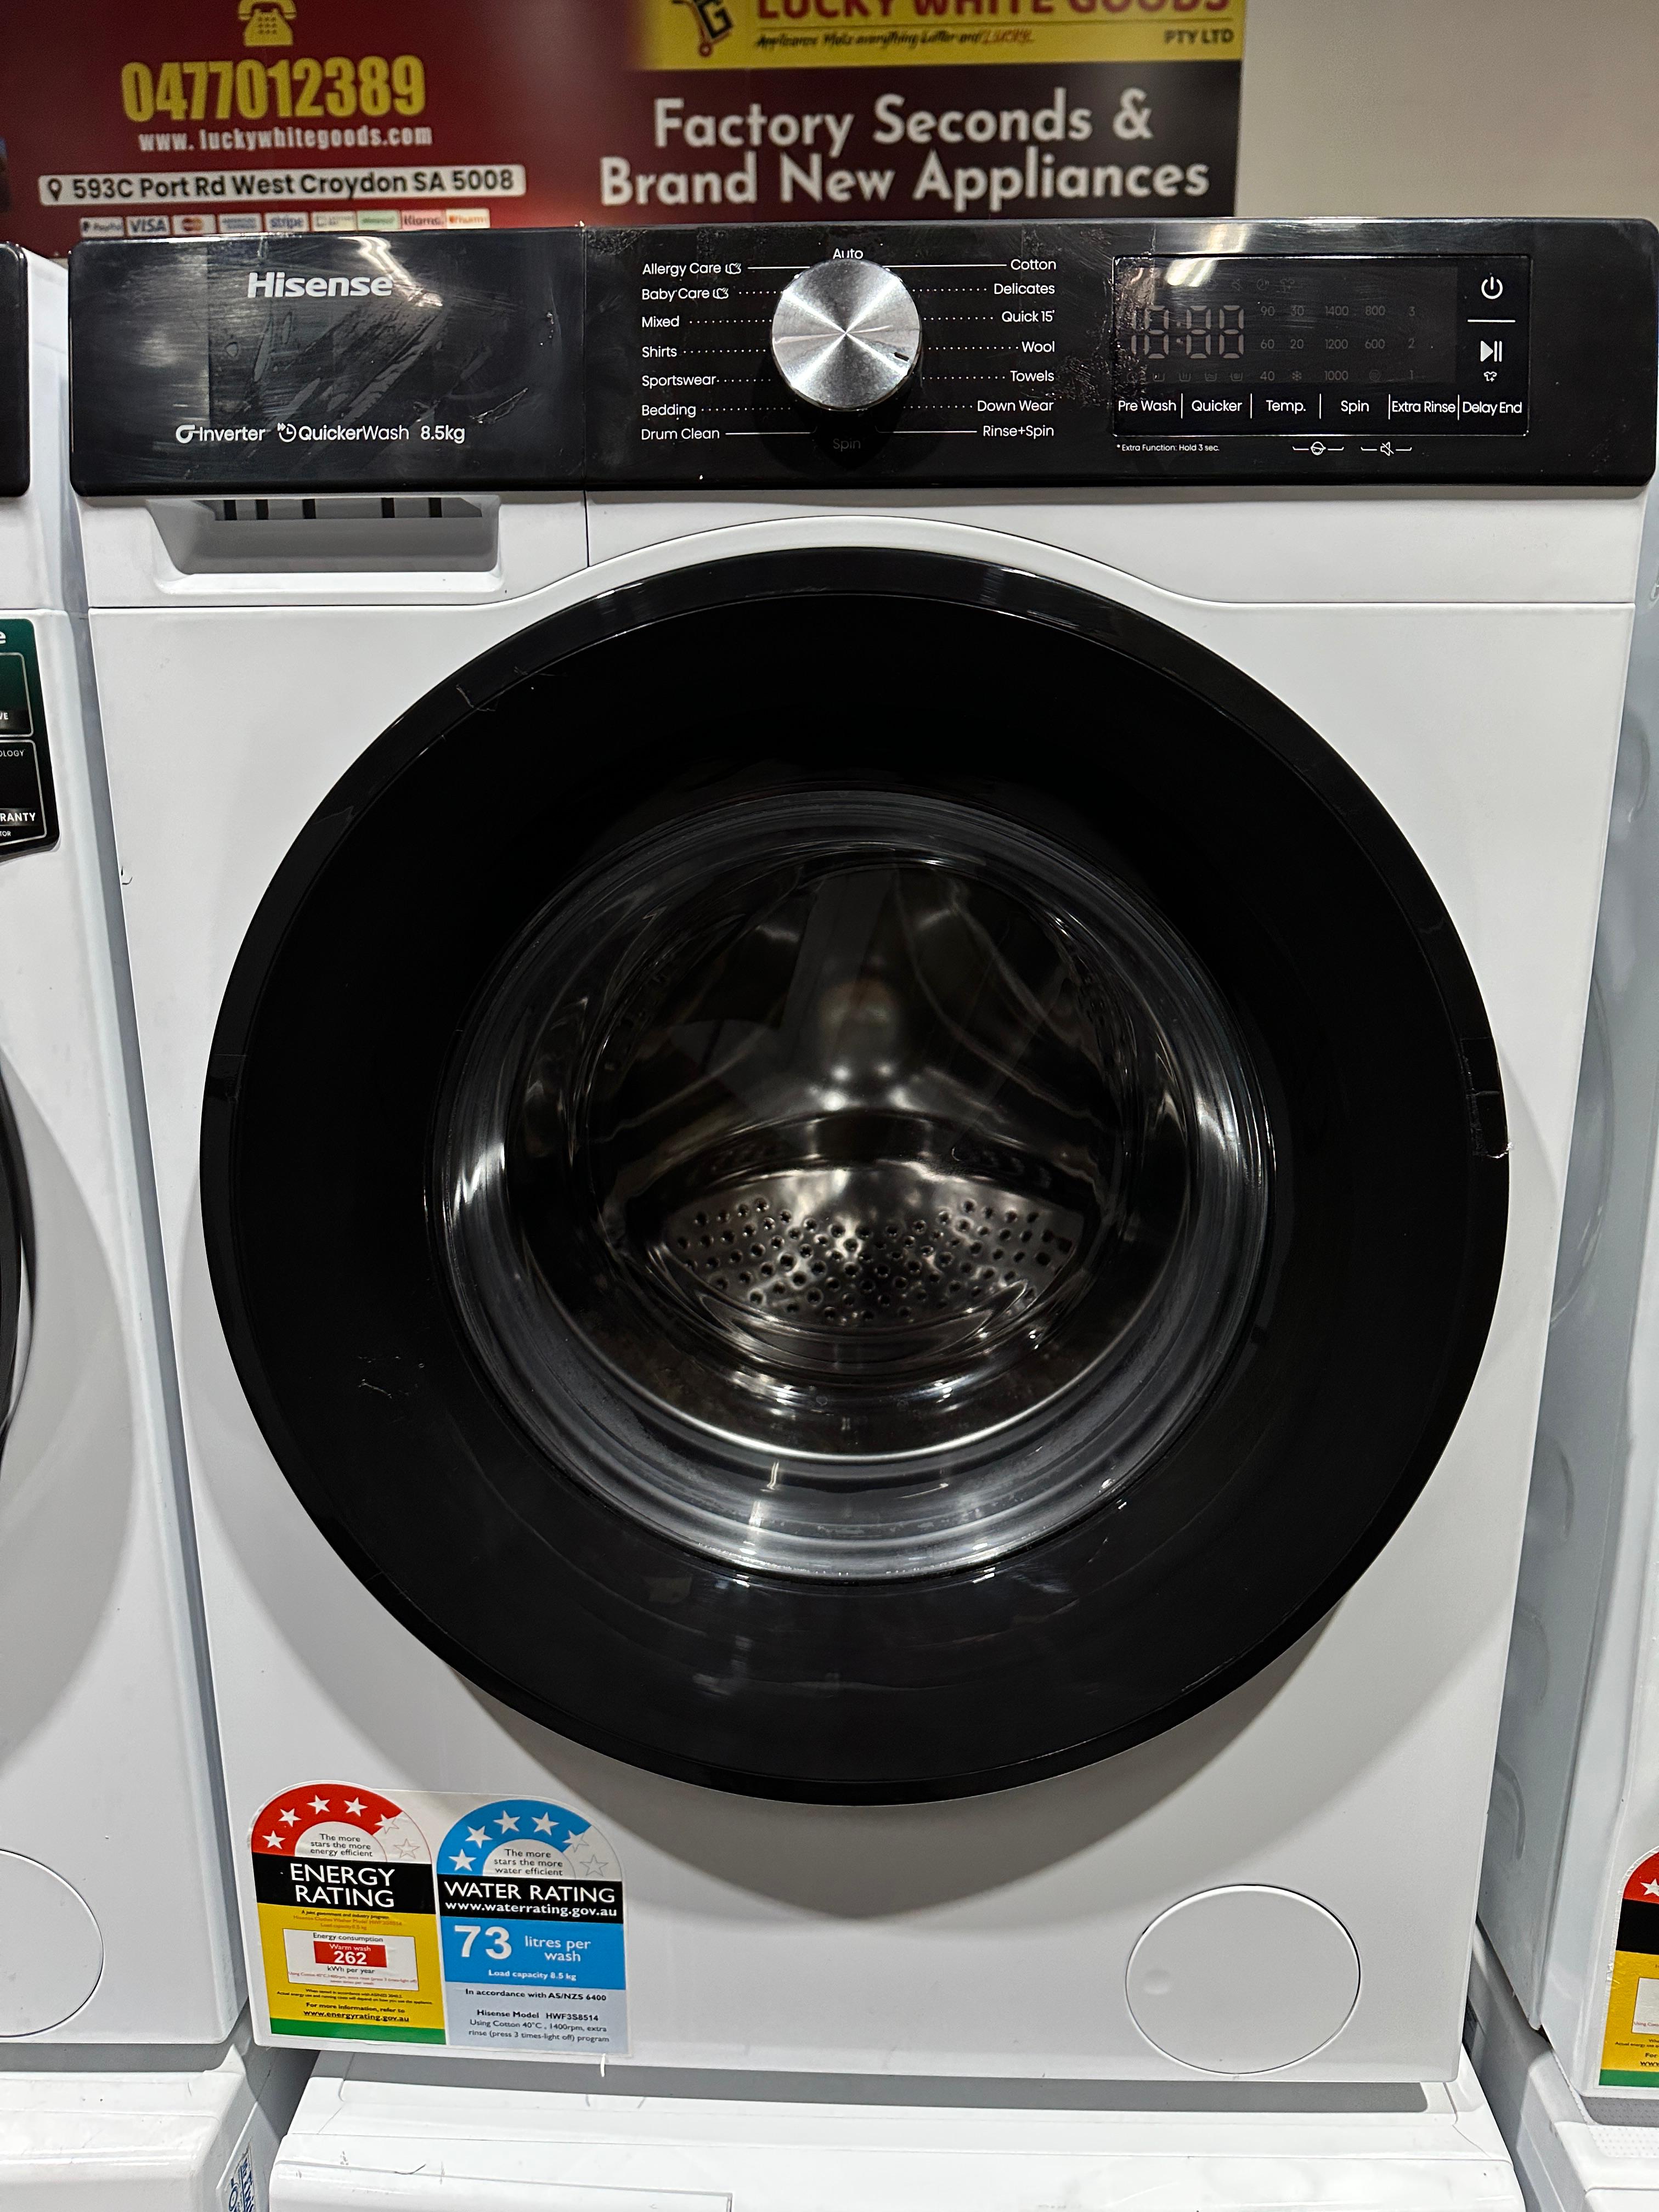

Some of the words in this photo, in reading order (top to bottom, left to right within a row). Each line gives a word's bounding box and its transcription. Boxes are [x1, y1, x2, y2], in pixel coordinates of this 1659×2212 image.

[1163, 30, 1197, 44] PTY
[1200, 29, 1234, 44] LTD
[121, 55, 426, 122] 0477012389
[653, 97, 855, 159] Factory
[873, 87, 1093, 144] Seconds
[1113, 88, 1153, 140] &
[72, 177, 133, 199] 593C
[140, 176, 190, 198] Port
[194, 174, 225, 196] Rd
[231, 172, 295, 195] West
[300, 171, 407, 200] Croydon
[413, 171, 445, 193] SA
[453, 168, 514, 191] 5008
[600, 150, 758, 206] Brand
[780, 152, 896, 203] New
[912, 145, 1210, 213] Appliances
[129, 217, 167, 233] VISA
[642, 263, 686, 278] Allergy
[689, 262, 721, 275] Care
[1011, 259, 1057, 271] Cotton
[247, 271, 394, 298] Hisense
[994, 283, 1056, 295] Delicates
[642, 289, 676, 302] Baby
[678, 287, 710, 300] Care
[1001, 311, 1039, 323] Quick
[1260, 306, 1276, 317] 90
[1290, 306, 1305, 317] 30
[1324, 306, 1349, 317] 1400
[1364, 306, 1386, 317] 800
[1408, 306, 1416, 317] 3
[642, 315, 680, 328] Mixed
[1022, 341, 1055, 353] Wool
[1260, 339, 1275, 349] 60
[1290, 339, 1304, 349] 20
[1324, 339, 1348, 349] 1200
[1364, 338, 1385, 349] 600
[1408, 338, 1415, 349] 2
[642, 346, 677, 358] Shirts
[642, 375, 716, 389] Sportswear
[1010, 370, 1054, 382] Towels
[1260, 370, 1276, 381] 40
[1324, 370, 1348, 381] 1000
[642, 404, 696, 418] Bedding
[977, 400, 1016, 412] Down
[1019, 400, 1054, 411] Wear
[1118, 400, 1138, 412] Pre
[1141, 400, 1177, 412] Wash
[1191, 399, 1243, 412] Quicker
[1265, 399, 1306, 415] Temp.
[1340, 399, 1370, 415] Spin
[1392, 400, 1421, 413] Extra
[1424, 400, 1455, 413] Rinse
[1463, 401, 1498, 416] Delay
[1499, 401, 1522, 413] End
[199, 425, 266, 442] Inverter
[298, 424, 410, 443] QuickerWash
[420, 425, 466, 445] 8.5kg
[641, 428, 678, 441] Drum
[681, 428, 720, 439] Clean
[983, 425, 1054, 440] Rinse+Spin
[833, 438, 861, 452] Spin
[310, 1848, 338, 1857] energy
[504, 1848, 523, 1857] The
[290, 1863, 395, 1887] ENERGY
[525, 1867, 563, 1876] efficient
[295, 1884, 394, 1908] RATING
[444, 1881, 522, 1900] WATER
[530, 1884, 615, 1903] RATING
[445, 1902, 617, 1918] www.waterrating.gov.au
[313, 1932, 336, 1941] Energy
[338, 1934, 383, 1943] consumption
[454, 1925, 512, 1960] 73
[525, 1935, 562, 1948] litres
[566, 1940, 591, 1952] per
[334, 1950, 367, 1965] 262
[544, 1950, 582, 1962] wash
[512, 1971, 548, 1980] capacity
[565, 1973, 577, 1981] kg
[303, 2010, 410, 2022] www.energyrating.gov.au
[477, 2009, 510, 2017] Hisense
[546, 2012, 599, 2021] HWF3S8514
[470, 2019, 491, 2028] Using
